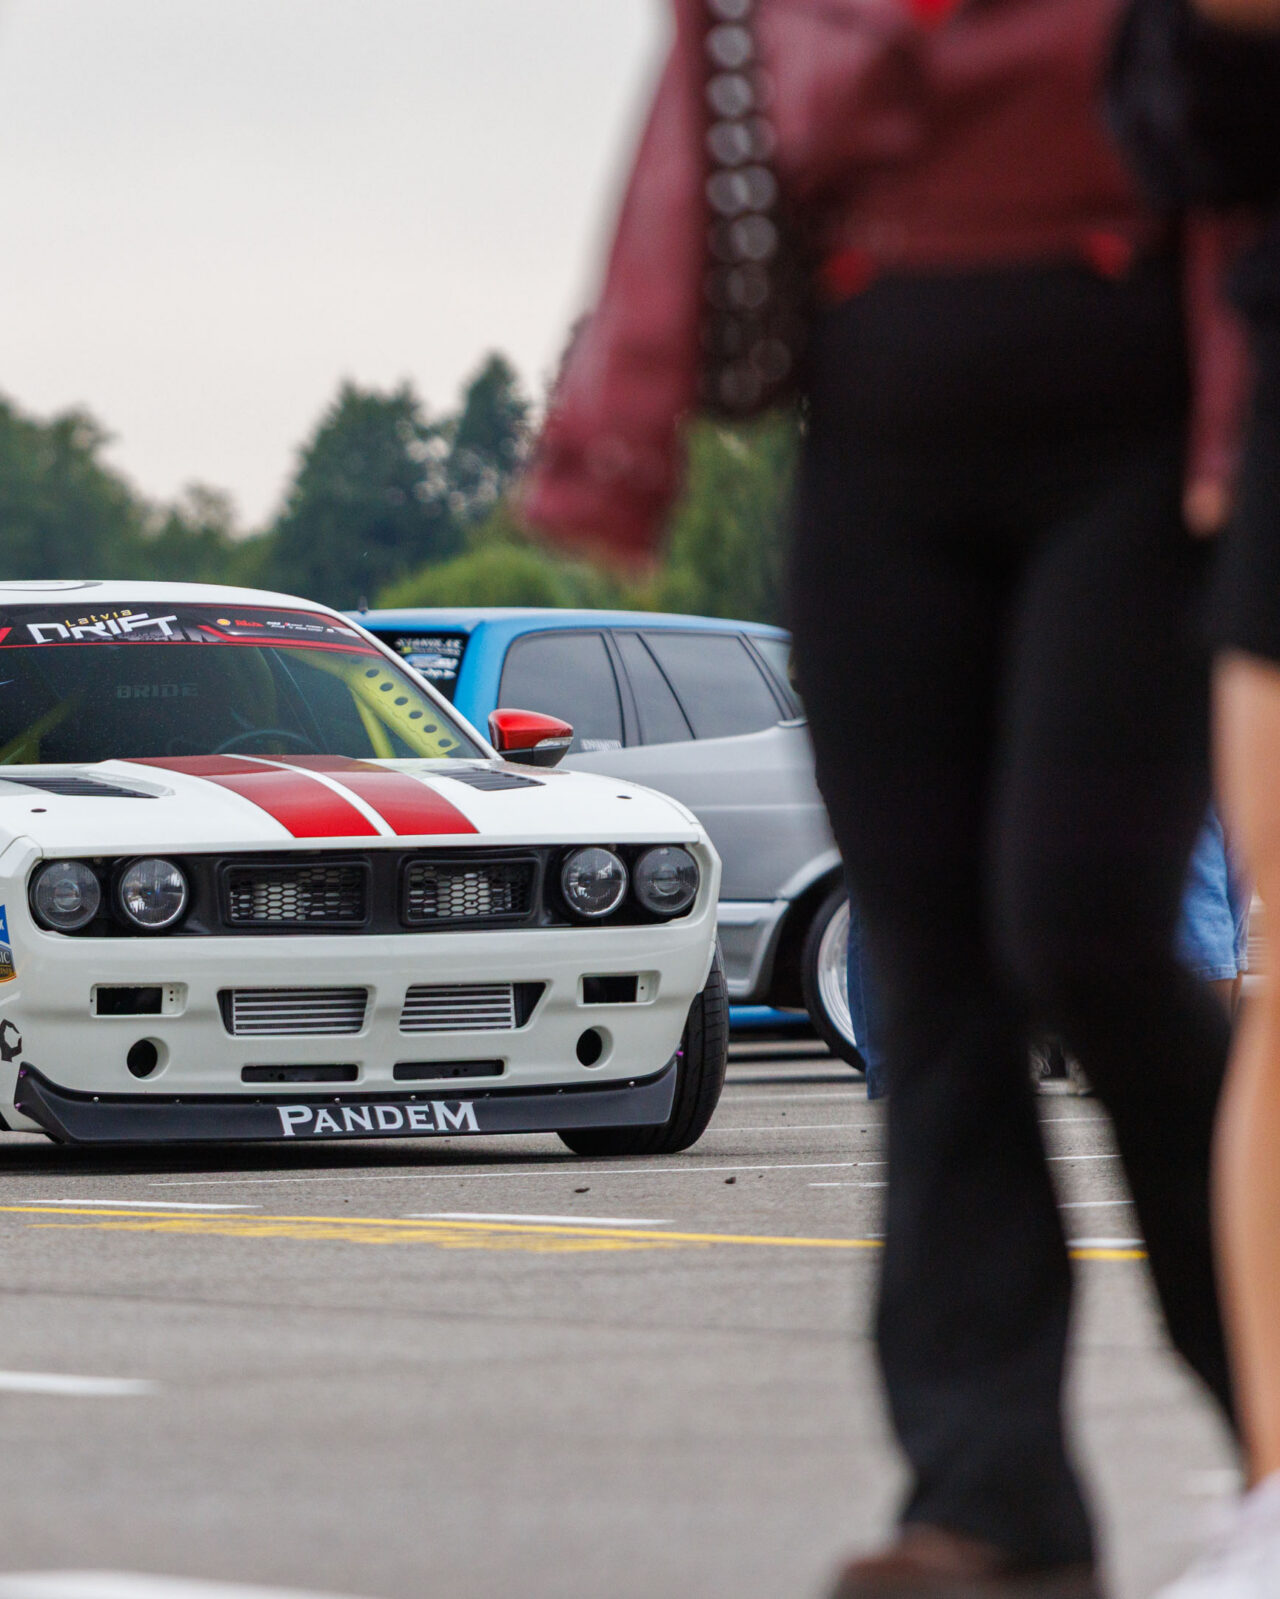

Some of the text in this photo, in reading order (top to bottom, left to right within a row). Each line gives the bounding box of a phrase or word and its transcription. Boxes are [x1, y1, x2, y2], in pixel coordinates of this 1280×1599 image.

[26, 612, 178, 644] DRIFT
[65, 609, 133, 628] Latvia
[116, 683, 199, 699] BRIDE
[276, 1100, 481, 1137] PANDEM
